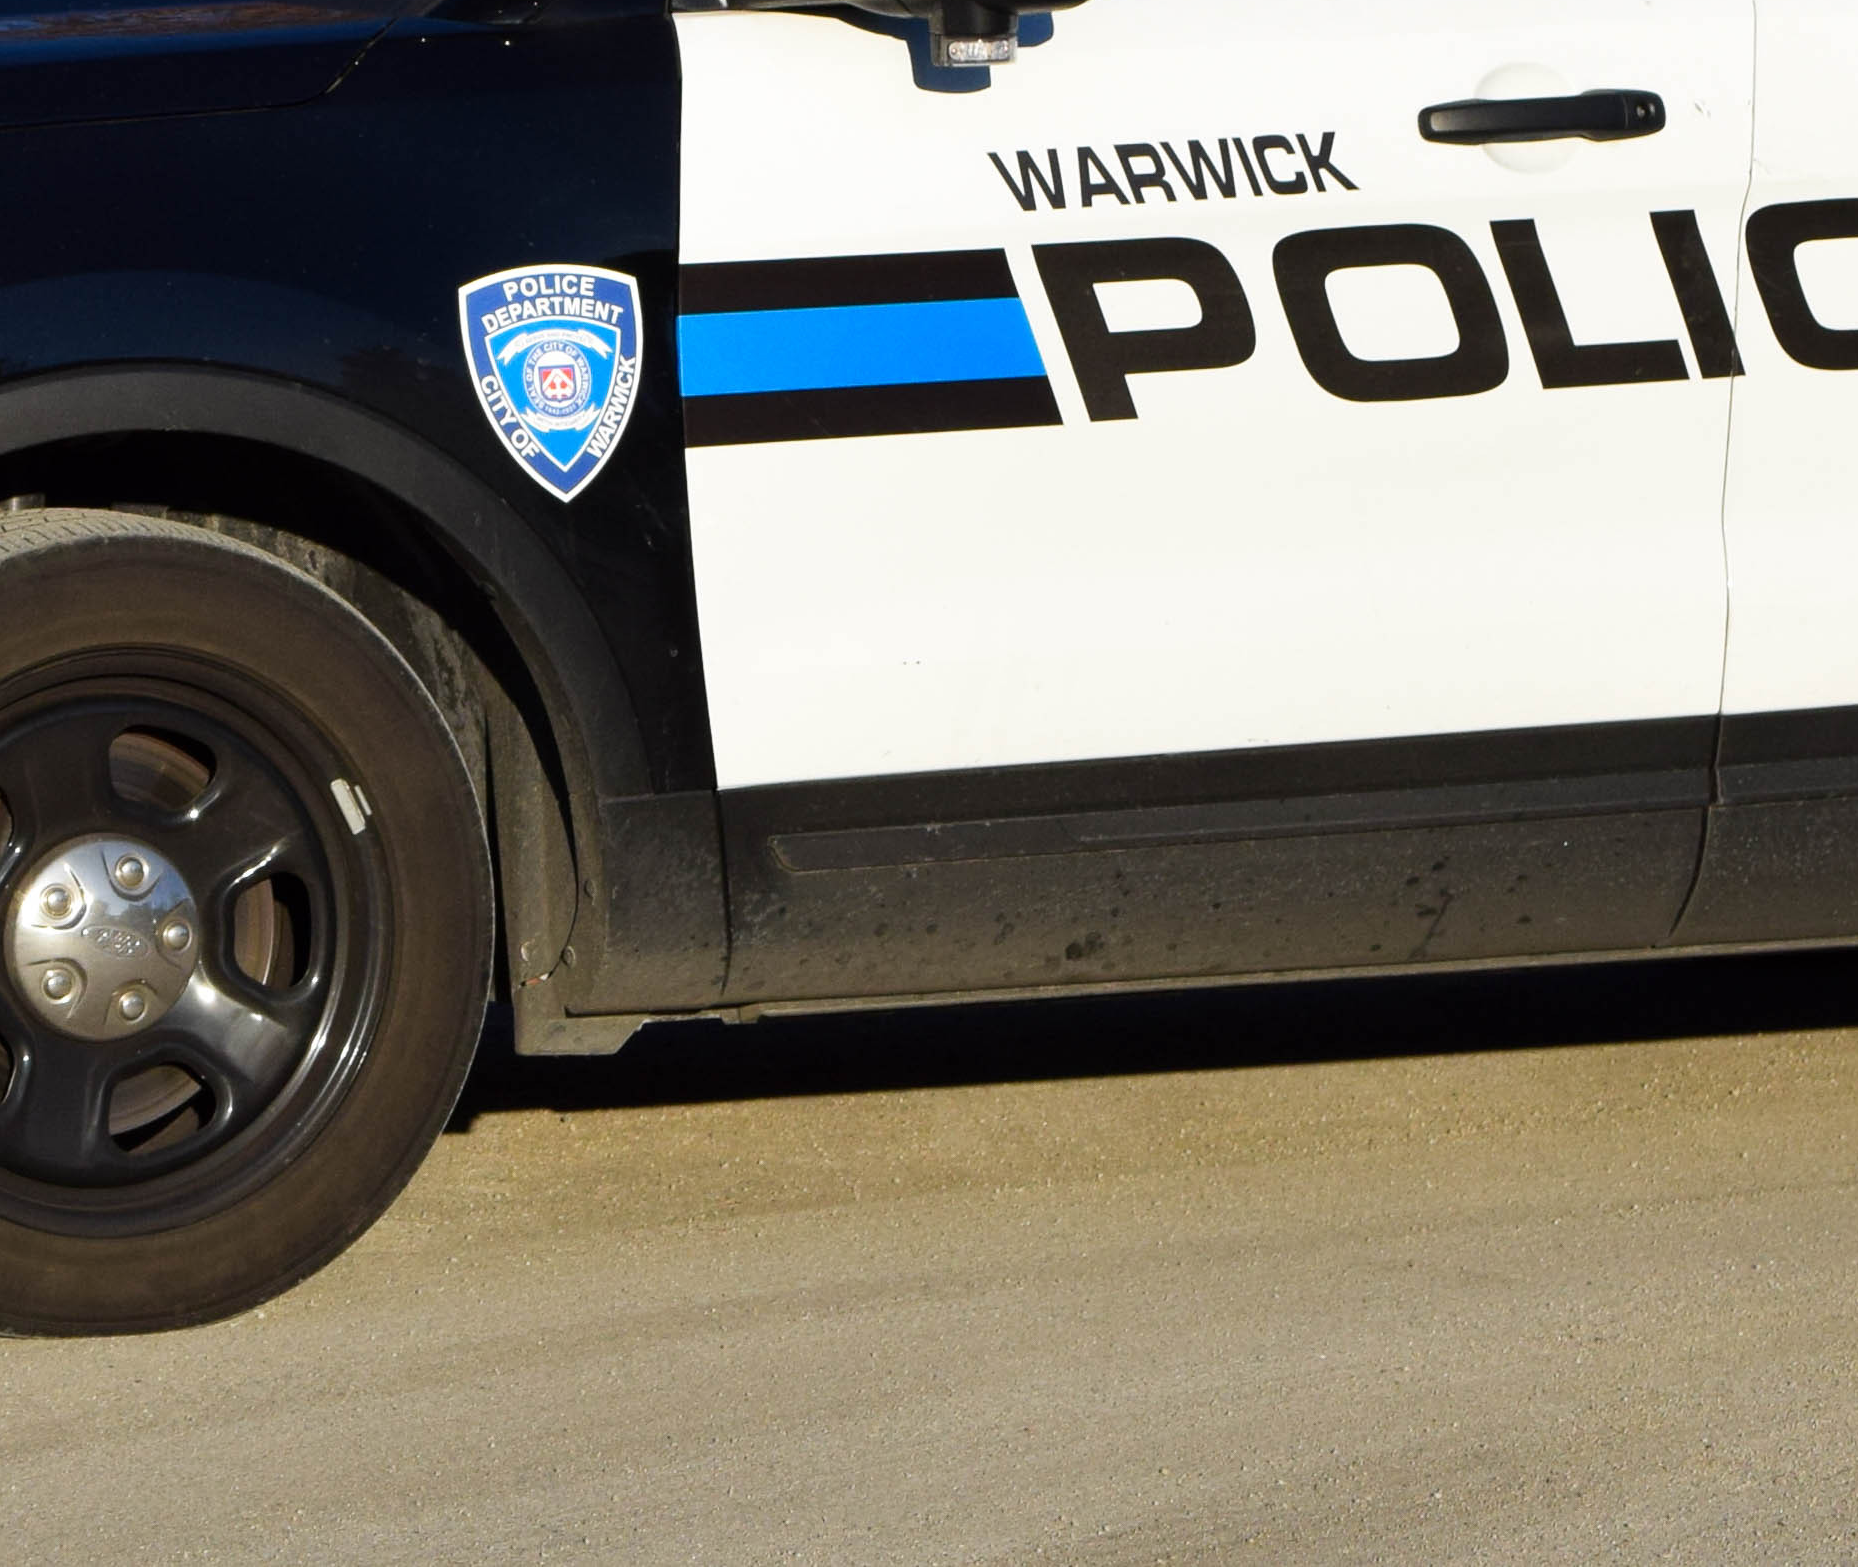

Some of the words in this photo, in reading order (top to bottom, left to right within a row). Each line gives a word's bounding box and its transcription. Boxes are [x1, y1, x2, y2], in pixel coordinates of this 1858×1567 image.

[988, 131, 1358, 211] WARWICK
[480, 296, 624, 334] DEPARTMENT
[502, 275, 596, 302] POLICE
[480, 374, 518, 425] CITY
[510, 431, 540, 460] OF
[585, 355, 637, 459] WARWICK
